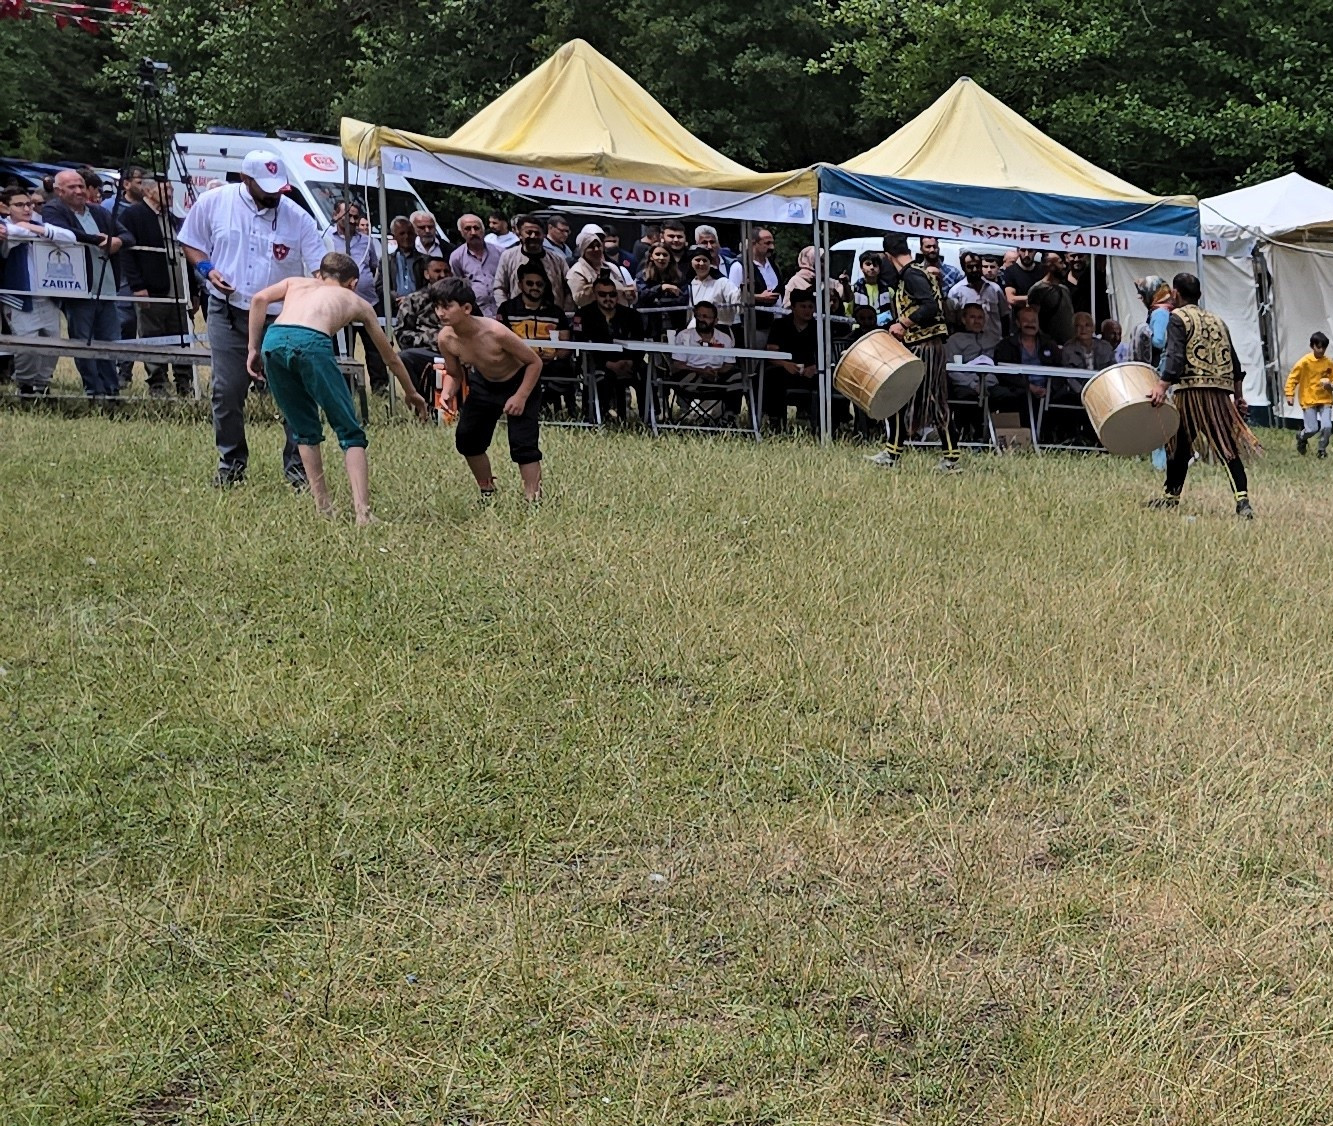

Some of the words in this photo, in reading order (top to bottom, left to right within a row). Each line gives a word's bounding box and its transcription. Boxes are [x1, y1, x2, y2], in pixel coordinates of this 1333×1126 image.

[517, 173, 604, 199] SAĞLIK
[610, 186, 691, 208] ÇADIRI
[892, 211, 963, 238] GÜREŞ
[971, 224, 1052, 245] KOMİTE
[1059, 231, 1130, 251] ÇADIRI
[42, 278, 82, 290] ZABITA
